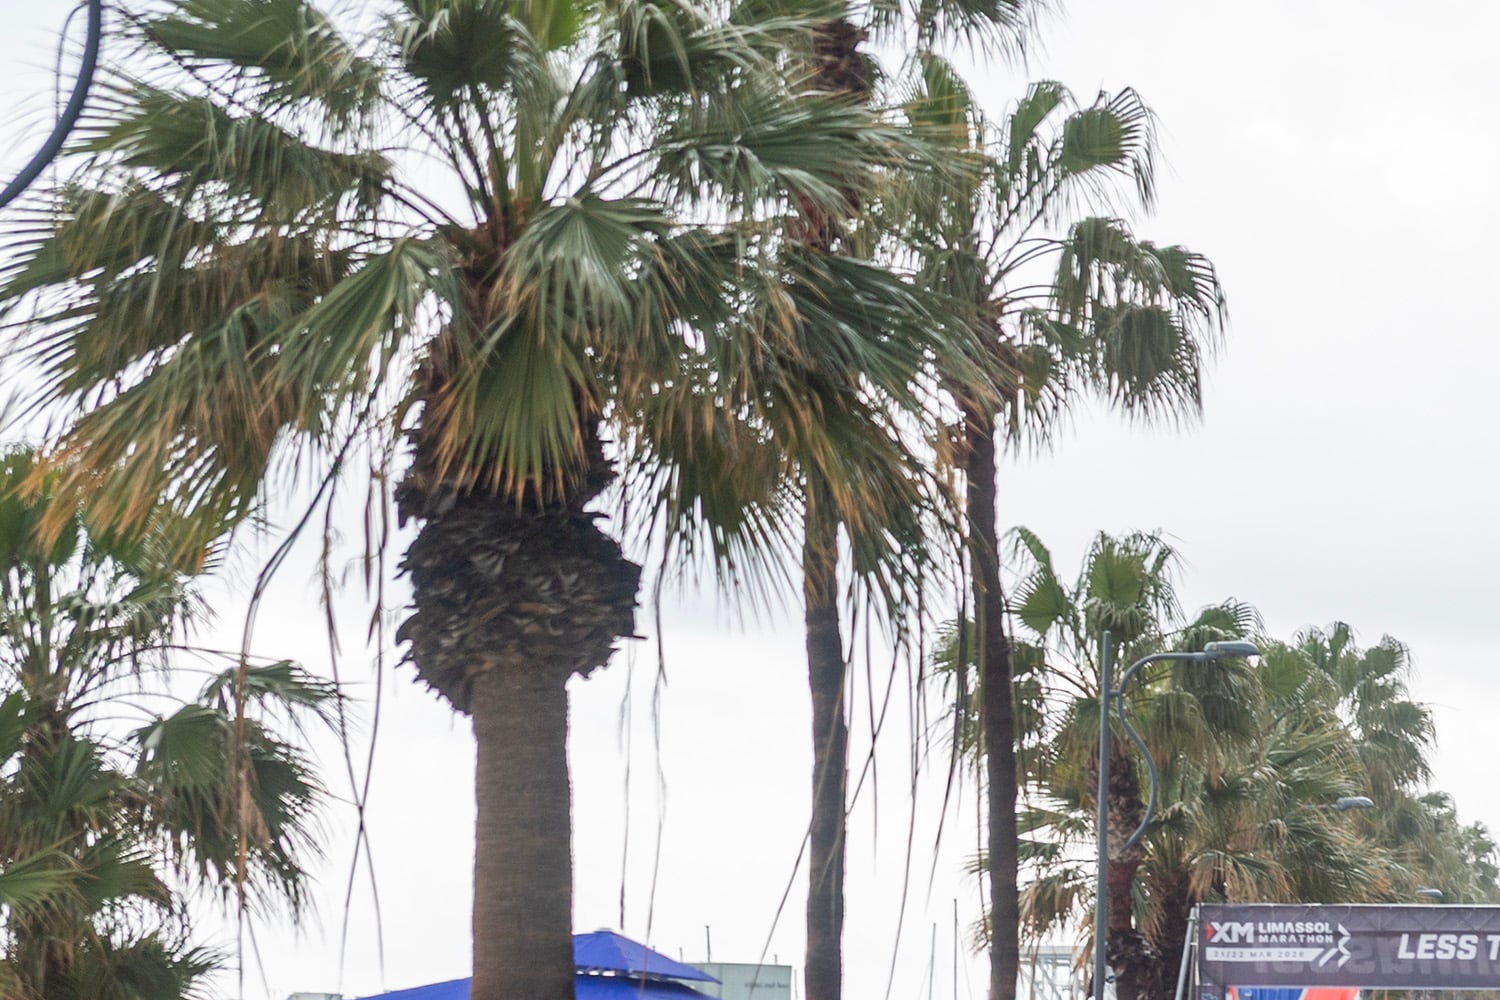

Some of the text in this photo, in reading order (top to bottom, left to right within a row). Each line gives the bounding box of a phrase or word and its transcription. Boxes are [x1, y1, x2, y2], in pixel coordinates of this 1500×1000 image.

[1210, 921, 1332, 943] XM LIMASSOL
[1258, 934, 1334, 944] MARATHON
[1397, 934, 1479, 960] LESS
